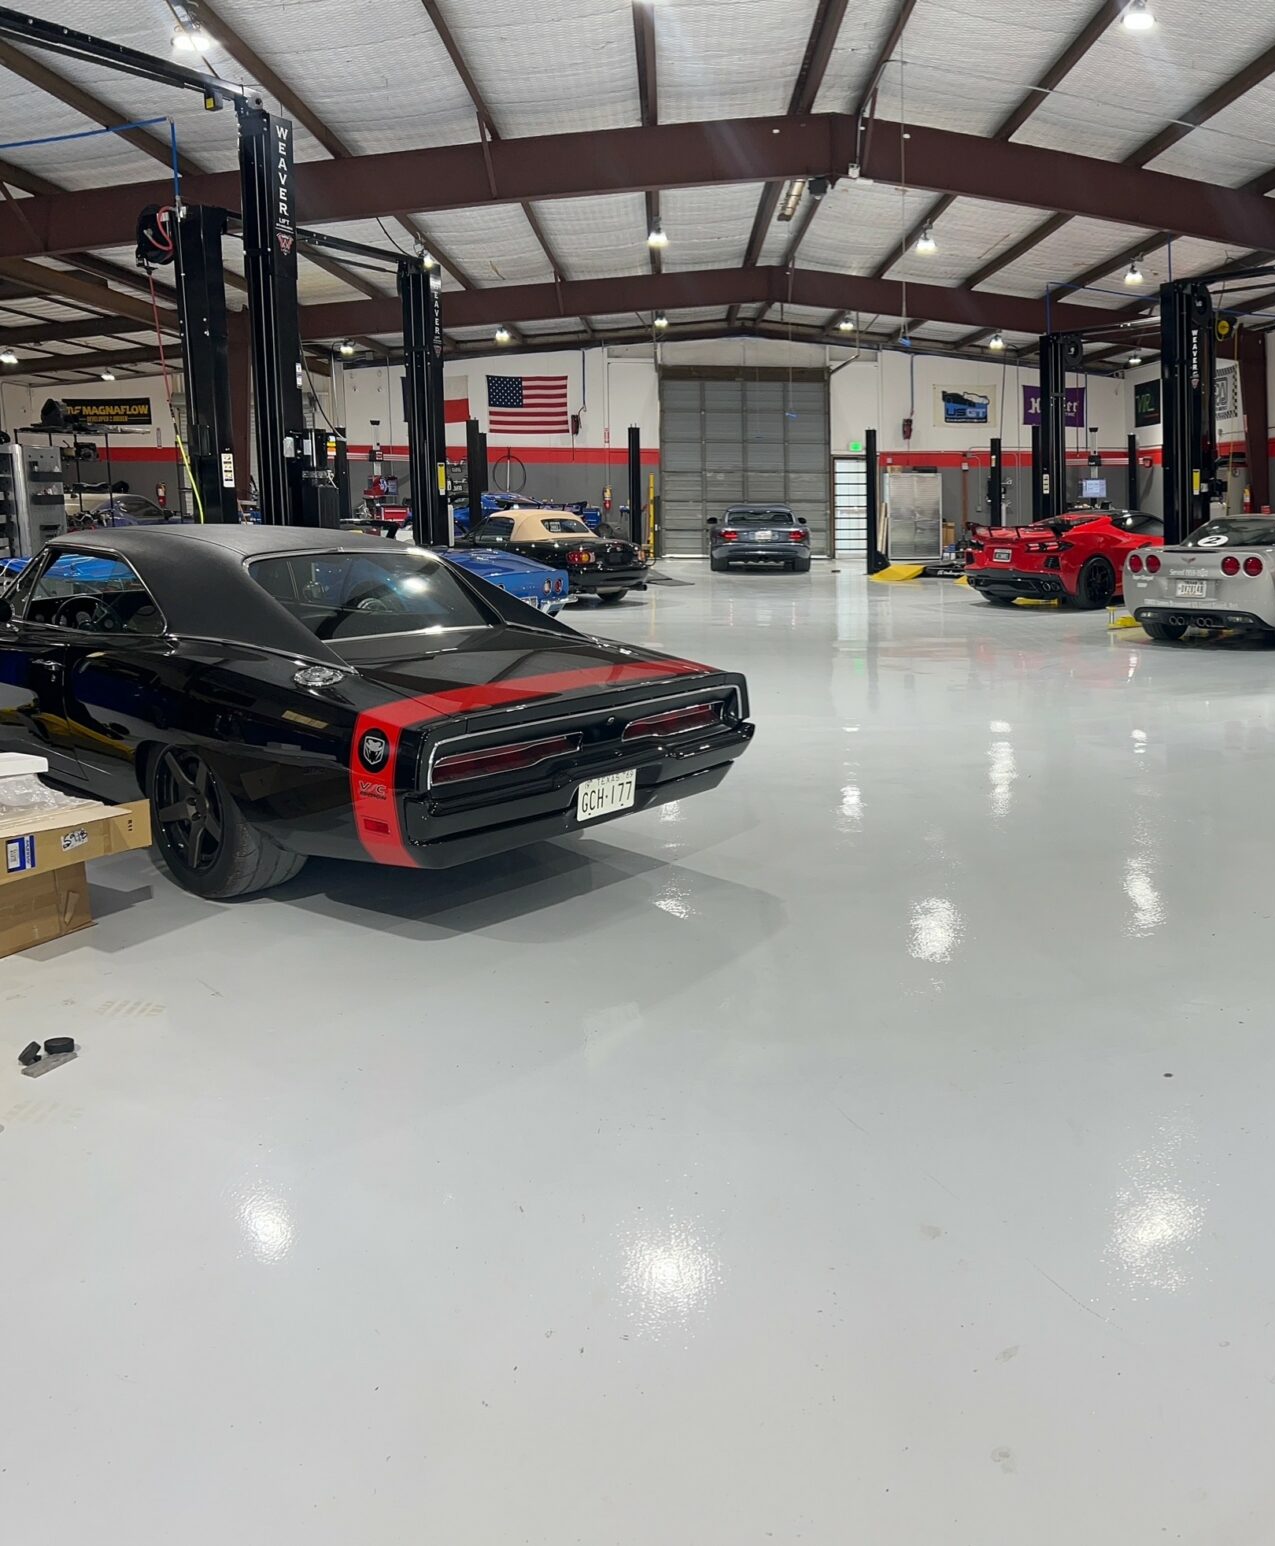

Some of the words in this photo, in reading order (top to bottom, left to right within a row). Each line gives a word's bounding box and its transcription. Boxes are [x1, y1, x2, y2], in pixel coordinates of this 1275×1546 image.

[275, 125, 289, 216] WEAVER
[82, 405, 149, 415] MAGNAFLOW
[946, 407, 986, 417] USGT
